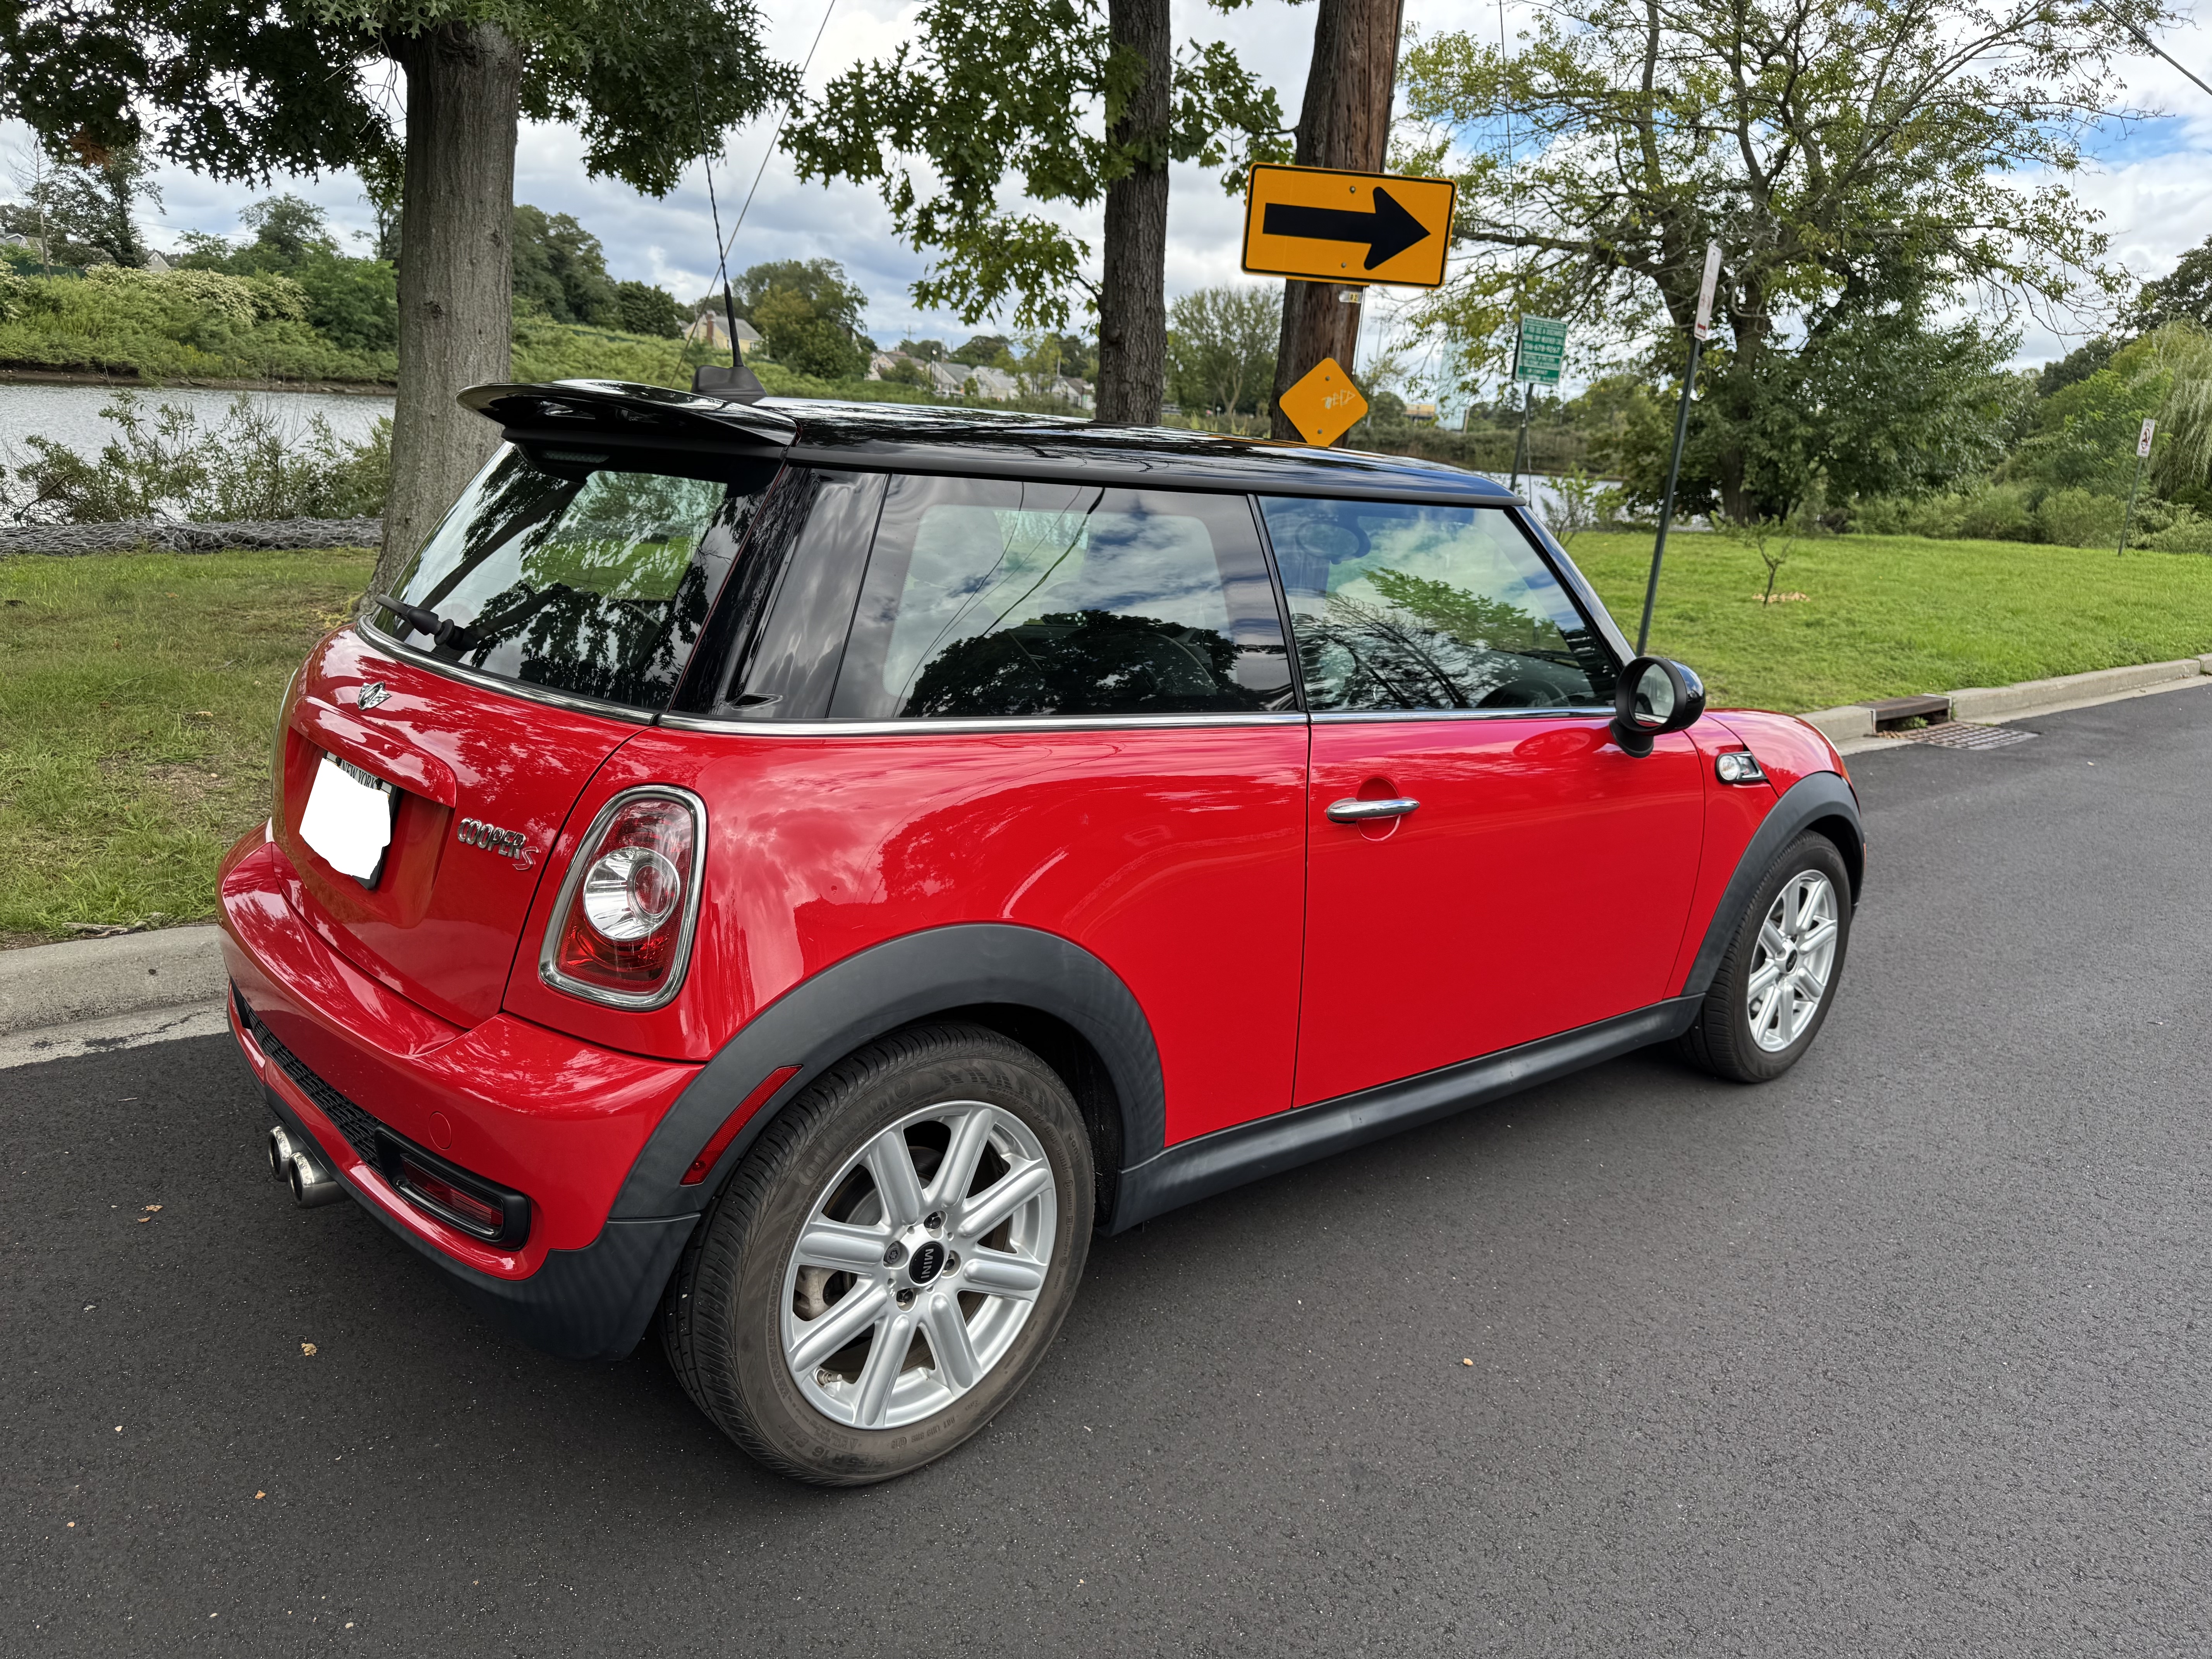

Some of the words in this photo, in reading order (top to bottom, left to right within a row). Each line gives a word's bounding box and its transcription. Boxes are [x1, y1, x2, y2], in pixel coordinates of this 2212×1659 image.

[341, 761, 357, 778] NEW
[358, 770, 378, 788] YORK
[457, 817, 527, 859] COOPER
[512, 847, 539, 870] S
[921, 1249, 934, 1278] MINI
